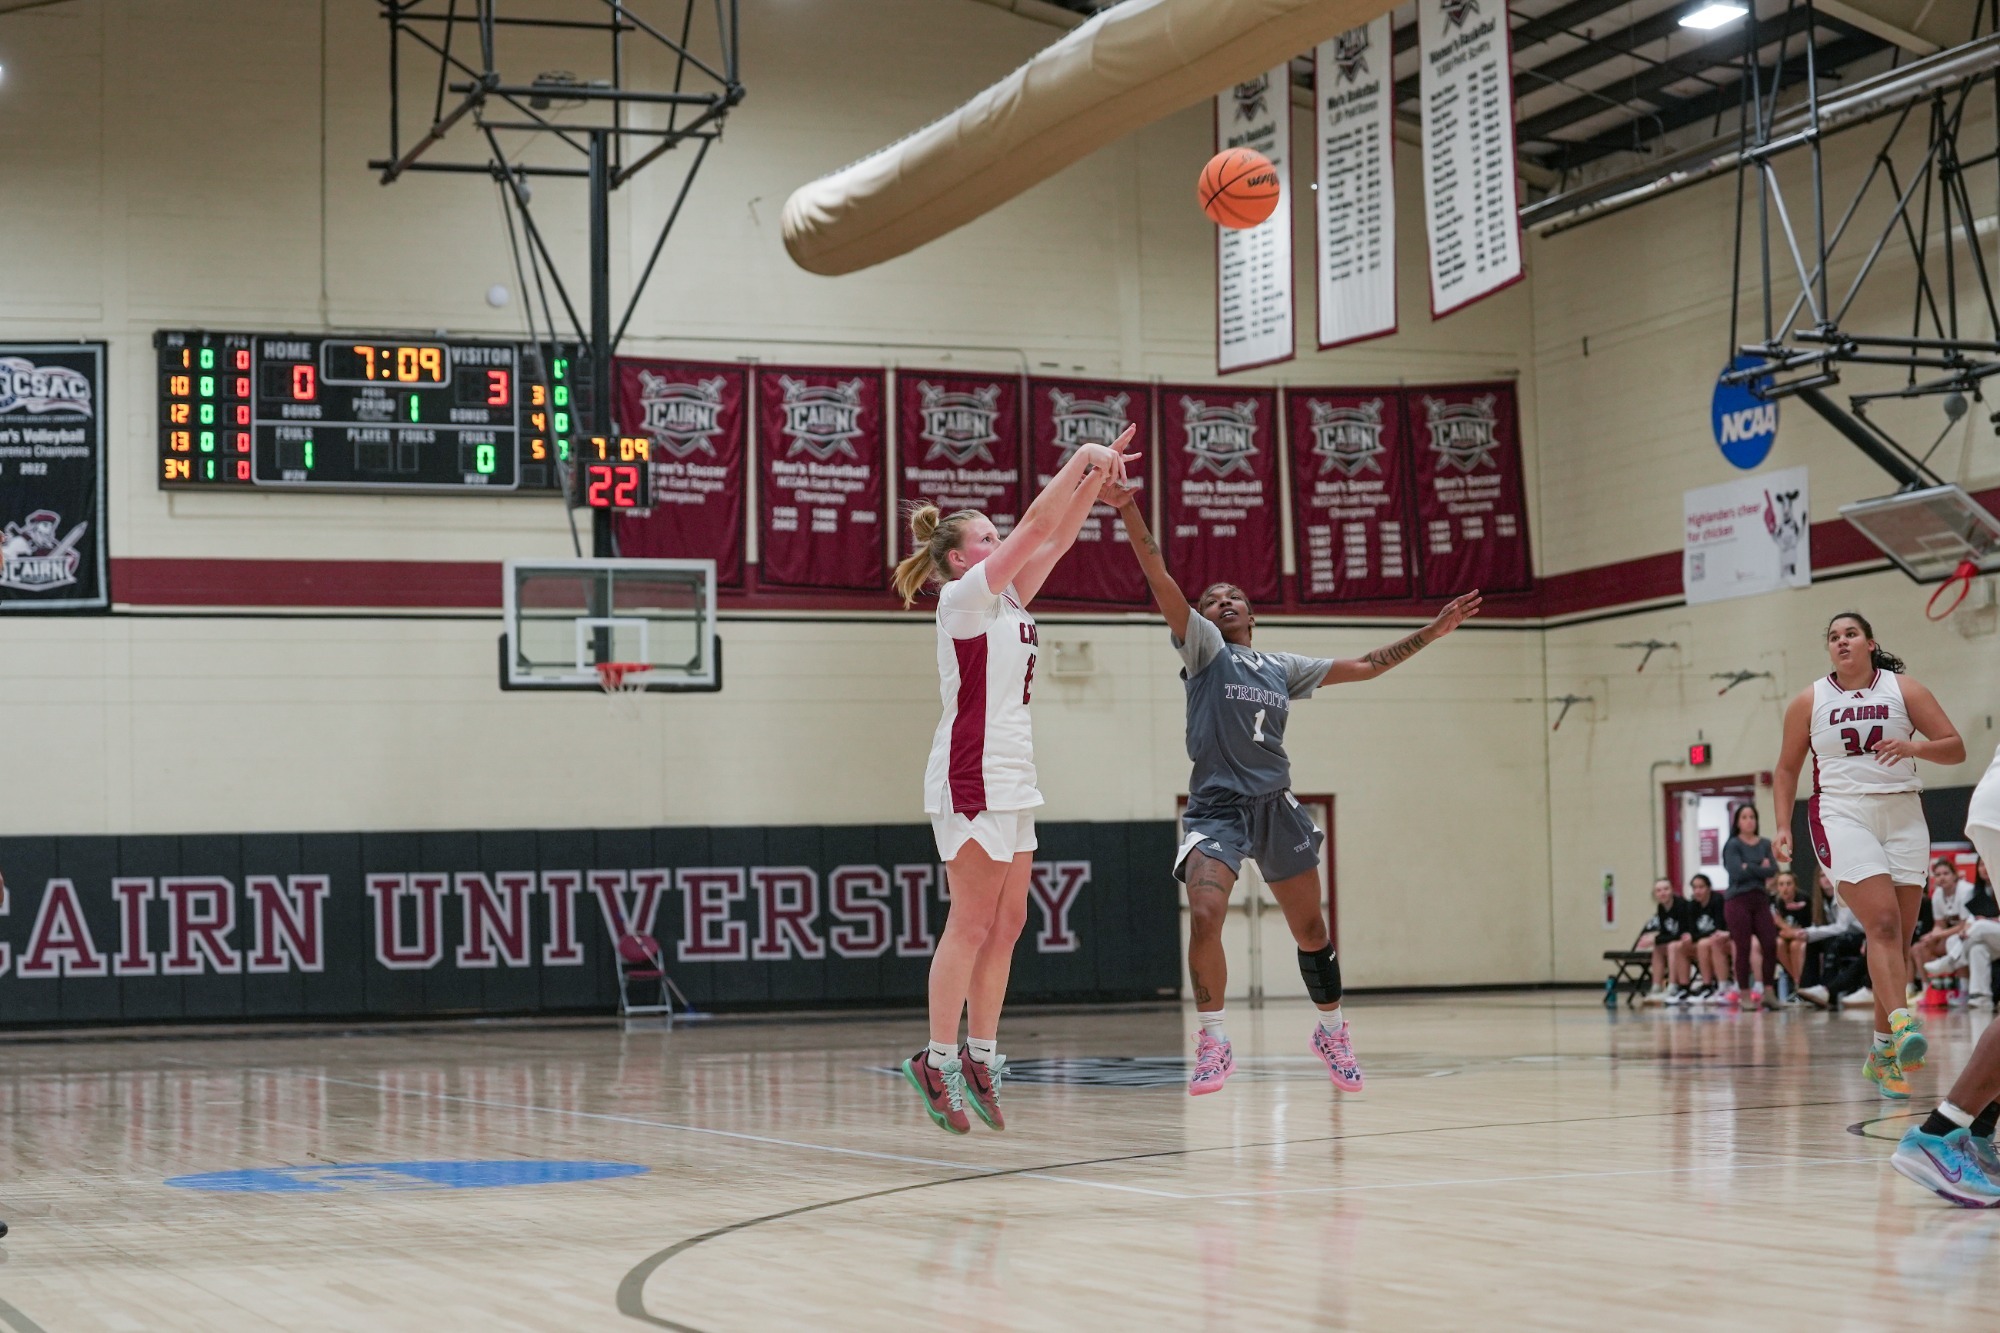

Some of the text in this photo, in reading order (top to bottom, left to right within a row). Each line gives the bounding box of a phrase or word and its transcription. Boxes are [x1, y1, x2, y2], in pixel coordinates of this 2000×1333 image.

[182, 348, 250, 370] 1 0 0
[263, 340, 312, 360] HOME
[451, 346, 513, 366] VISITOR
[353, 345, 441, 382] 7:09
[12, 371, 86, 399] CSAC
[170, 375, 250, 398] 10 0 0
[293, 364, 315, 400] 0
[487, 370, 509, 406] 3
[532, 385, 545, 407] 3
[170, 403, 250, 425] 12 0 0
[282, 404, 323, 419] BONUS
[410, 394, 419, 423] 1
[449, 408, 490, 424] BONUS
[652, 402, 710, 430] CAIRN
[793, 404, 850, 433] CAIRN
[275, 426, 314, 441] FOULS
[531, 412, 568, 433] 4 0
[931, 411, 988, 437] CAIRN
[1062, 419, 1118, 444] CAIRN
[1721, 403, 1776, 445] NCAA
[22, 427, 86, 446] Volleyball
[170, 431, 250, 453] 13 0 0
[347, 428, 436, 444] PLAYER FOULS
[458, 430, 496, 444] FOULS
[1194, 425, 1247, 451] CAIRN
[1322, 426, 1375, 451] CAIRN
[1437, 421, 1488, 447] CAIRN
[33, 444, 91, 460] Champions
[304, 441, 313, 469] 1
[476, 444, 495, 474] 0
[531, 439, 547, 460] 5
[164, 458, 250, 480] 34 1 0
[685, 462, 728, 479] Soccer
[771, 460, 871, 480] Men's Basketball
[905, 466, 956, 482] Women's
[957, 467, 1018, 483] Basketball
[588, 465, 639, 507] 22
[1181, 480, 1215, 494] Men's
[1688, 502, 1761, 527] Highlanders cheer
[1687, 525, 1734, 543] for chicken
[9, 560, 65, 582] CAIRN
[1252, 708, 1266, 742] 1
[1829, 704, 1889, 726] CAIRN
[1840, 725, 1884, 757] 34
[0, 860, 1092, 979] AIRN UNIVERSIY
